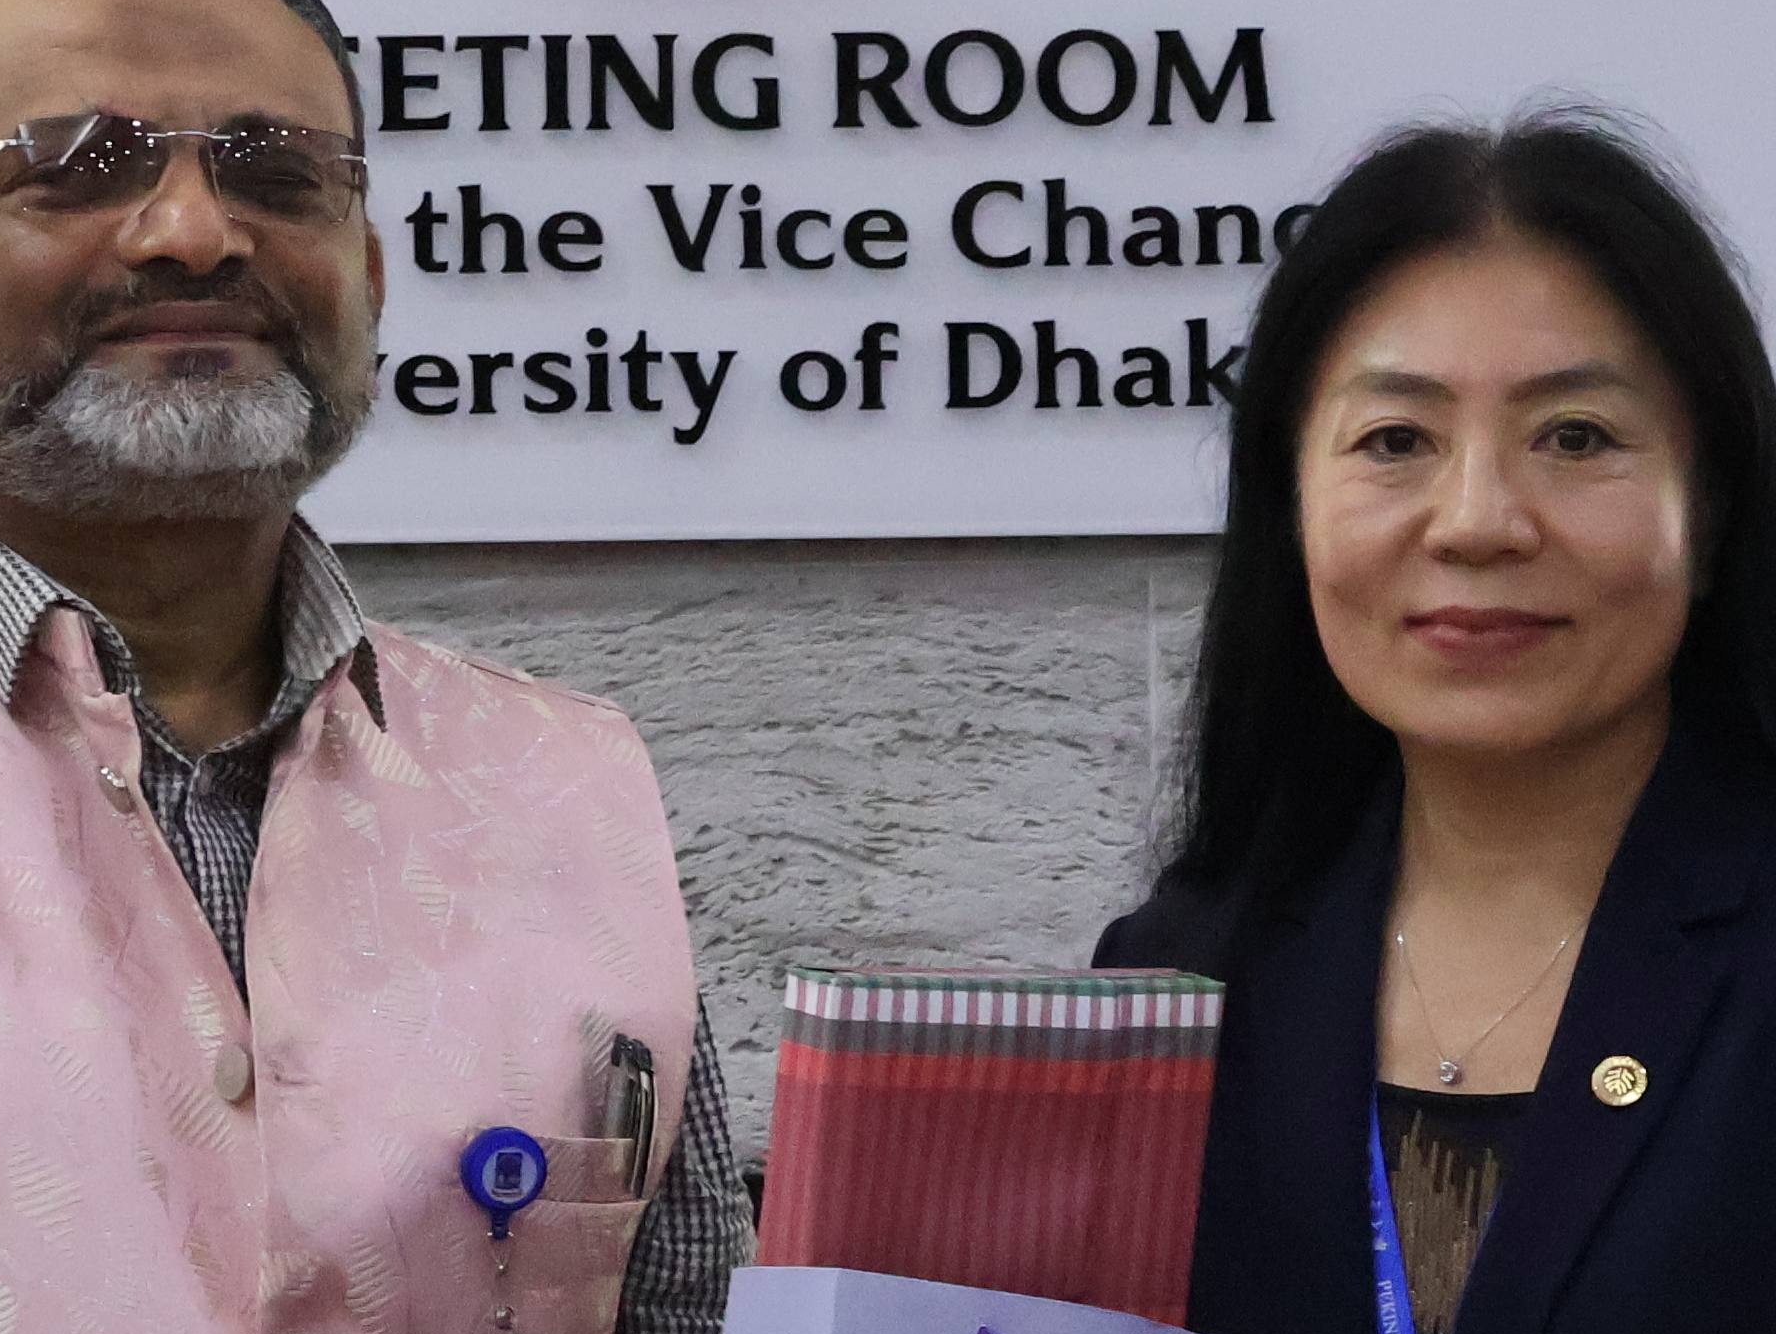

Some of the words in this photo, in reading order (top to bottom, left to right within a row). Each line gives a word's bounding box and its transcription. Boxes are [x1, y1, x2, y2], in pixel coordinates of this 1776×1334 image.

[342, 33, 781, 133] ETING
[832, 28, 1276, 129] ROOM
[405, 184, 604, 274] the
[646, 183, 909, 273] Vice
[376, 326, 739, 445] ersity
[779, 321, 900, 413] of
[944, 317, 1246, 410] Dhak
